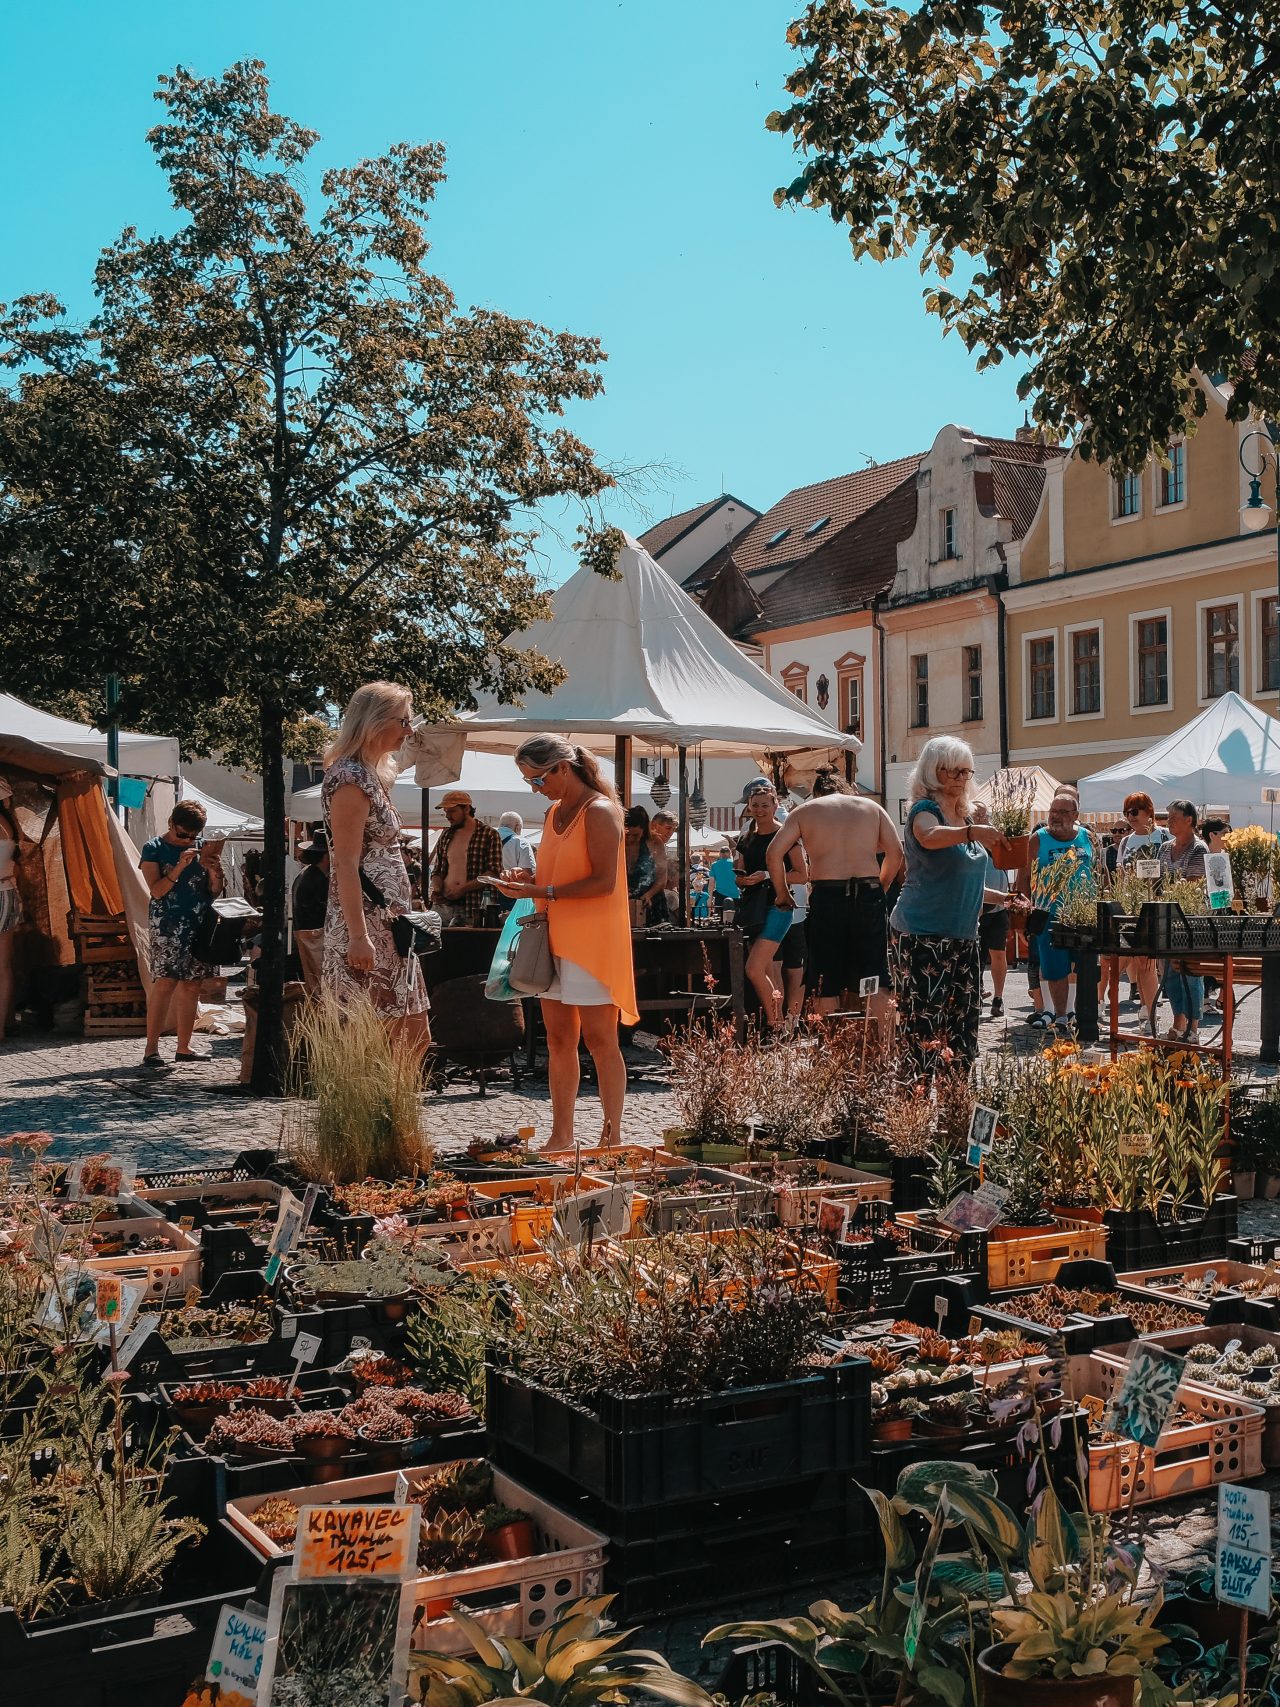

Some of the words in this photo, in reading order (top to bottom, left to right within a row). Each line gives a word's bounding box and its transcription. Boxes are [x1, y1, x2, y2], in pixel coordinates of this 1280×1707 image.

[1224, 1490, 1247, 1505] HOSTA
[308, 1509, 405, 1533] KRVAVEC
[1229, 1523, 1259, 1549] 125,-
[328, 1547, 392, 1574] 125,-
